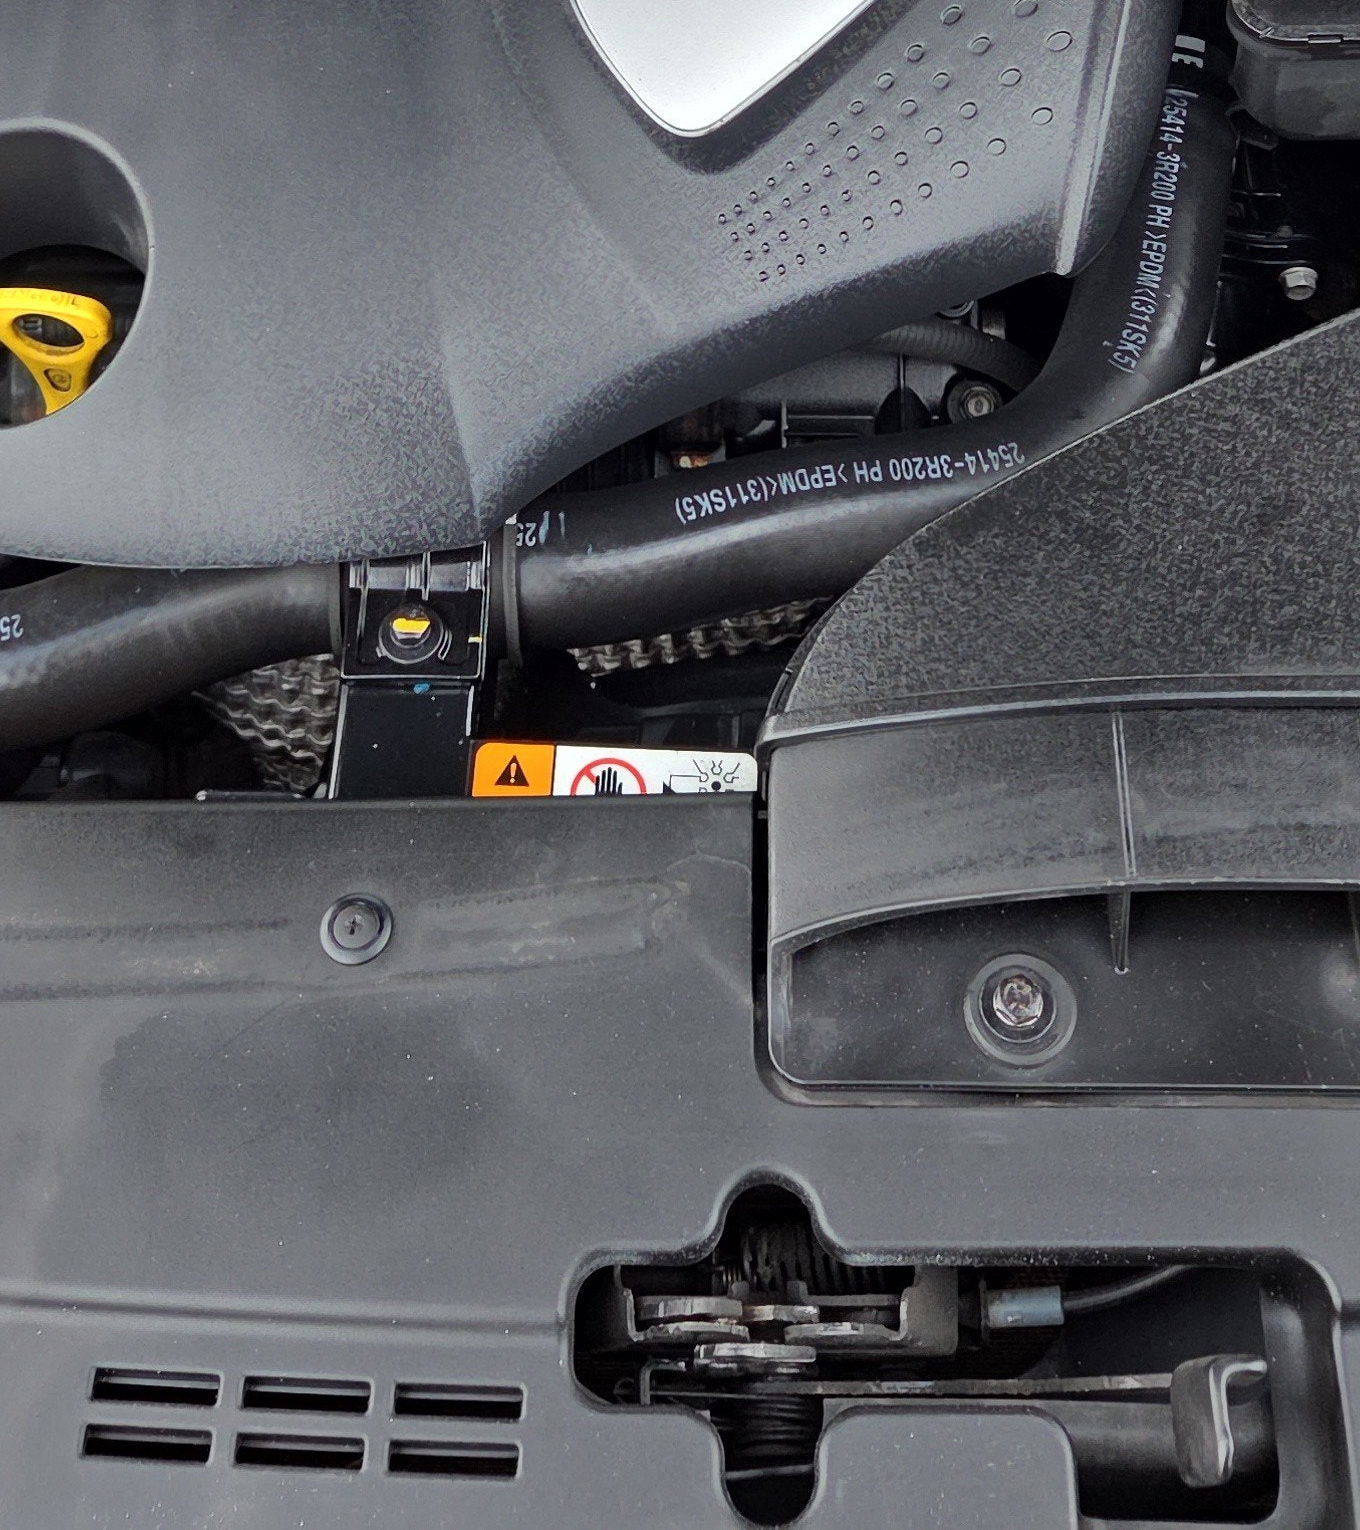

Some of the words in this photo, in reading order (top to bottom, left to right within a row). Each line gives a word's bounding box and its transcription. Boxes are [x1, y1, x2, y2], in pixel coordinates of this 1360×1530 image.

[1149, 95, 1189, 202] 25414-3R200
[1145, 203, 1174, 229] PH
[854, 461, 883, 484] PH
[889, 441, 1026, 481] 25414-3R200
